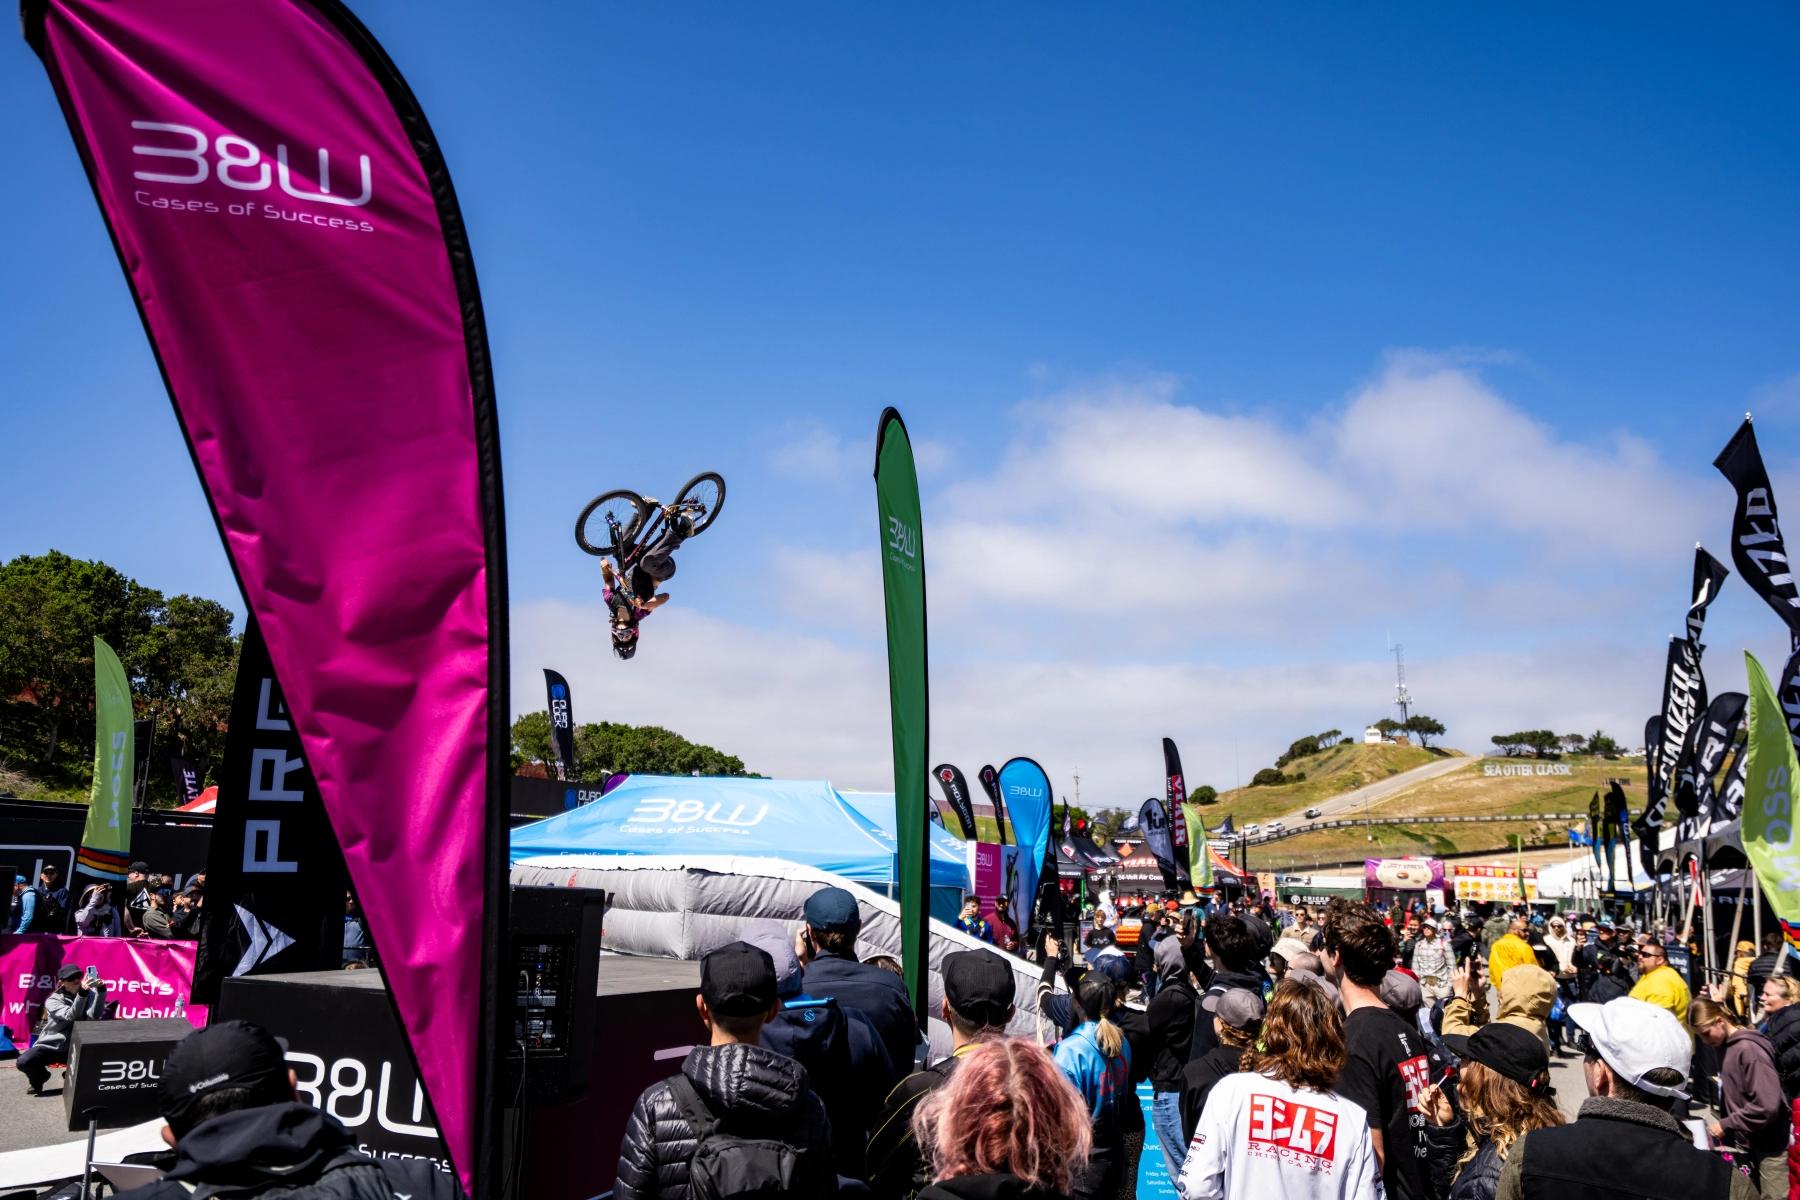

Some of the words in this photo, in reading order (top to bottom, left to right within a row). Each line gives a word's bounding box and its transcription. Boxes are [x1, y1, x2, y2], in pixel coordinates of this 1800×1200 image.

[131, 120, 372, 206] B&W
[135, 191, 219, 213] Cases
[228, 203, 255, 216] of
[263, 205, 374, 232] Success
[108, 731, 127, 828] MOSS
[1484, 764, 1501, 776] SEA
[1504, 764, 1533, 776] OTTER
[1536, 764, 1573, 776] CLASSIC
[627, 798, 769, 827] B&W
[619, 824, 663, 834] Cases
[668, 826, 684, 834] of
[687, 826, 751, 835] Success
[106, 978, 174, 996] otects
[98, 1083, 127, 1091] Cases
[1247, 1142, 1333, 1169] RACING
